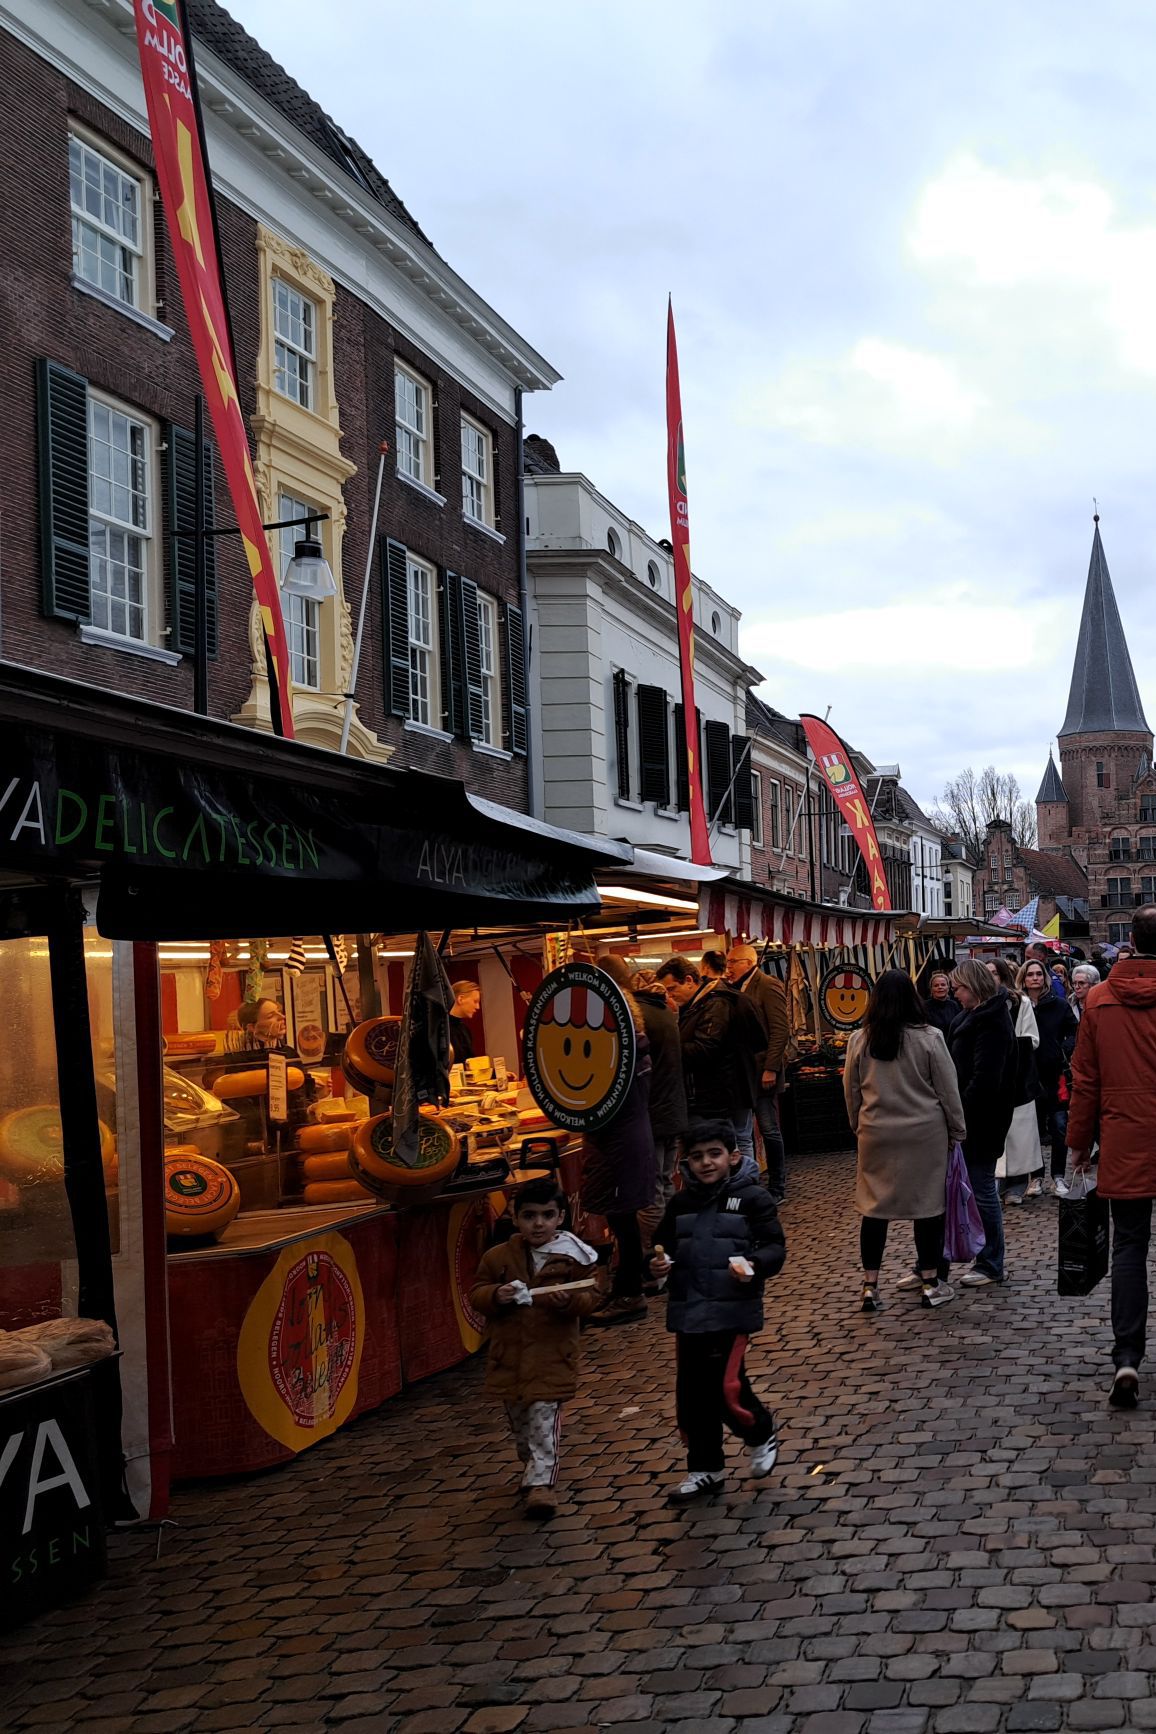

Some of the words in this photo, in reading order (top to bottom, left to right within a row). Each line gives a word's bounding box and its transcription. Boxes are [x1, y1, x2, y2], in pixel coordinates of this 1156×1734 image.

[54, 786, 319, 870] DELICATESSEN
[416, 839, 467, 887] ALYA
[568, 971, 600, 988] WELKOM
[599, 982, 612, 997] BIJ
[526, 981, 559, 1048] KAASCENTRUM
[609, 995, 629, 1046] HOLLAND
[527, 1051, 546, 1102] HOLLAND
[596, 1047, 629, 1118] KAASCENTRUM
[541, 1096, 554, 1113] BIJ
[552, 1110, 586, 1127] WELKOM
[270, 1320, 283, 1359] BELEGEN
